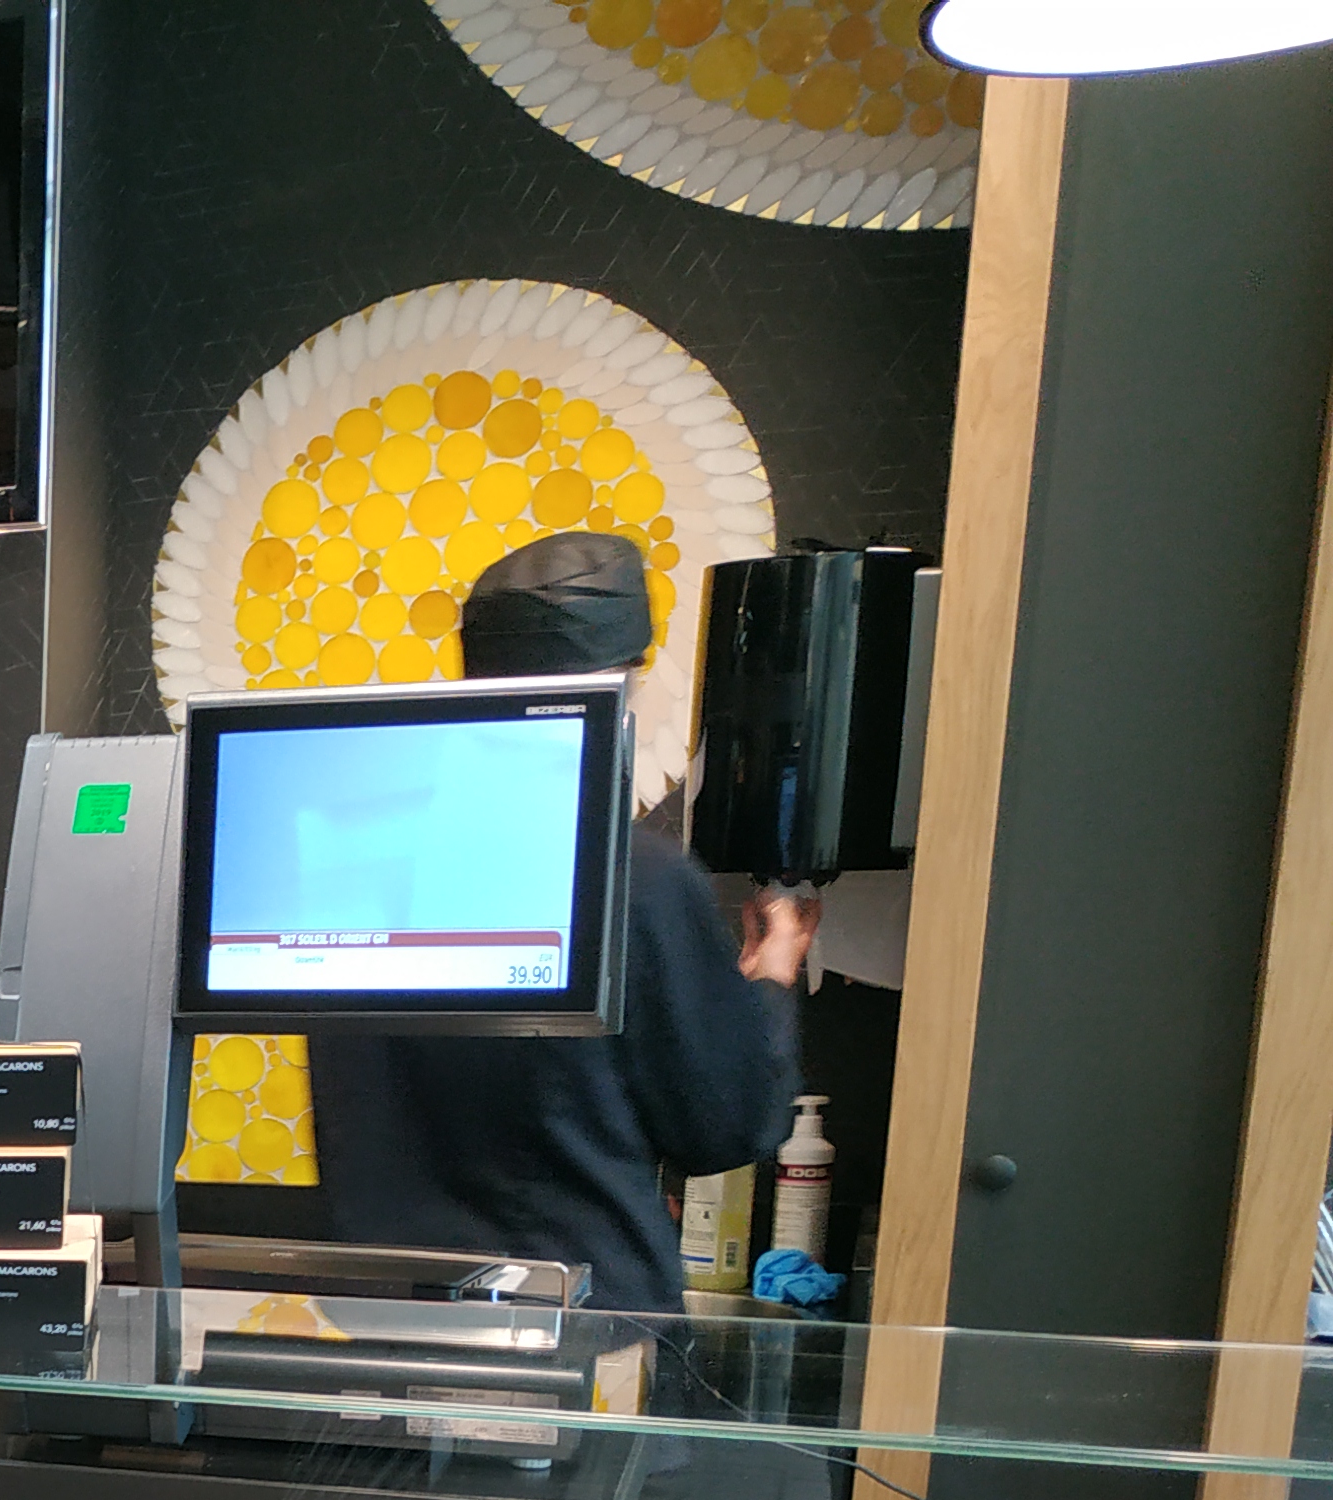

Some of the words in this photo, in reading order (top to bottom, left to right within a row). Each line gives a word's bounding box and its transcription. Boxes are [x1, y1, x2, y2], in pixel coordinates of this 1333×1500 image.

[507, 965, 552, 985] 39,90
[33, 1118, 60, 1130] 10,80
[18, 1219, 46, 1231] 21,60
[39, 1323, 68, 1335] 43,20
